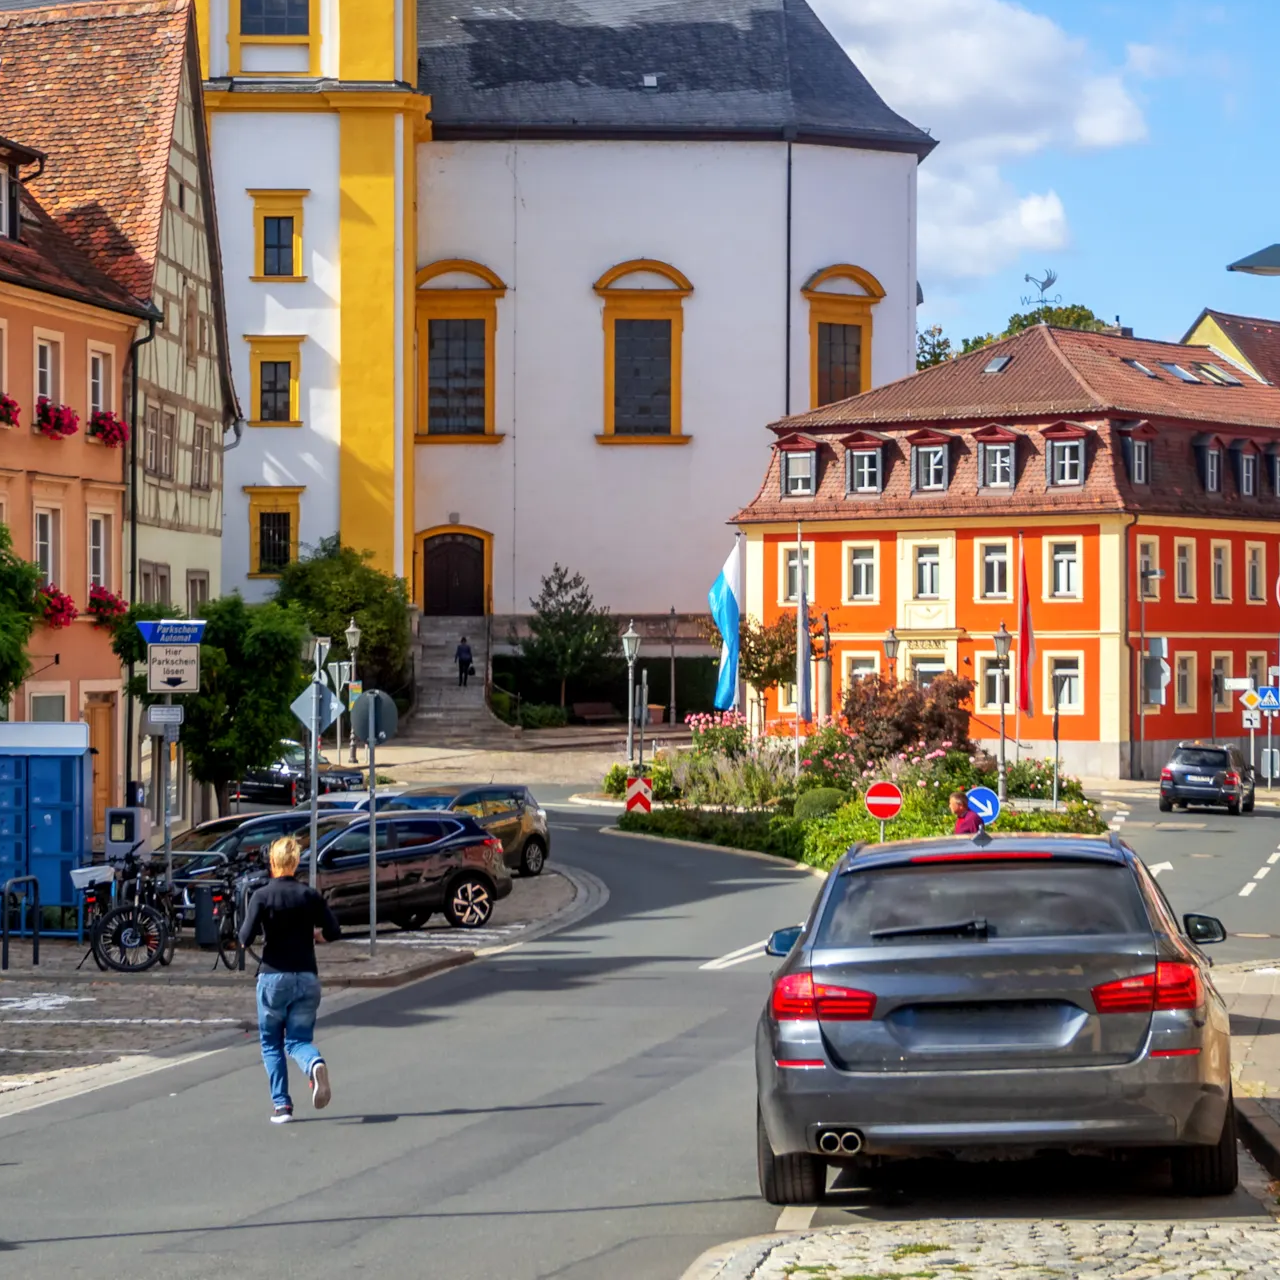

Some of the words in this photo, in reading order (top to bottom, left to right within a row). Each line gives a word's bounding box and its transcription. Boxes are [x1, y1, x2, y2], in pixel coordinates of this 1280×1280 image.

[157, 624, 198, 634] Parkschein
[160, 634, 192, 642] Automat
[165, 648, 182, 656] Hier
[152, 657, 196, 666] Parkschein
[163, 667, 185, 675] lösen
